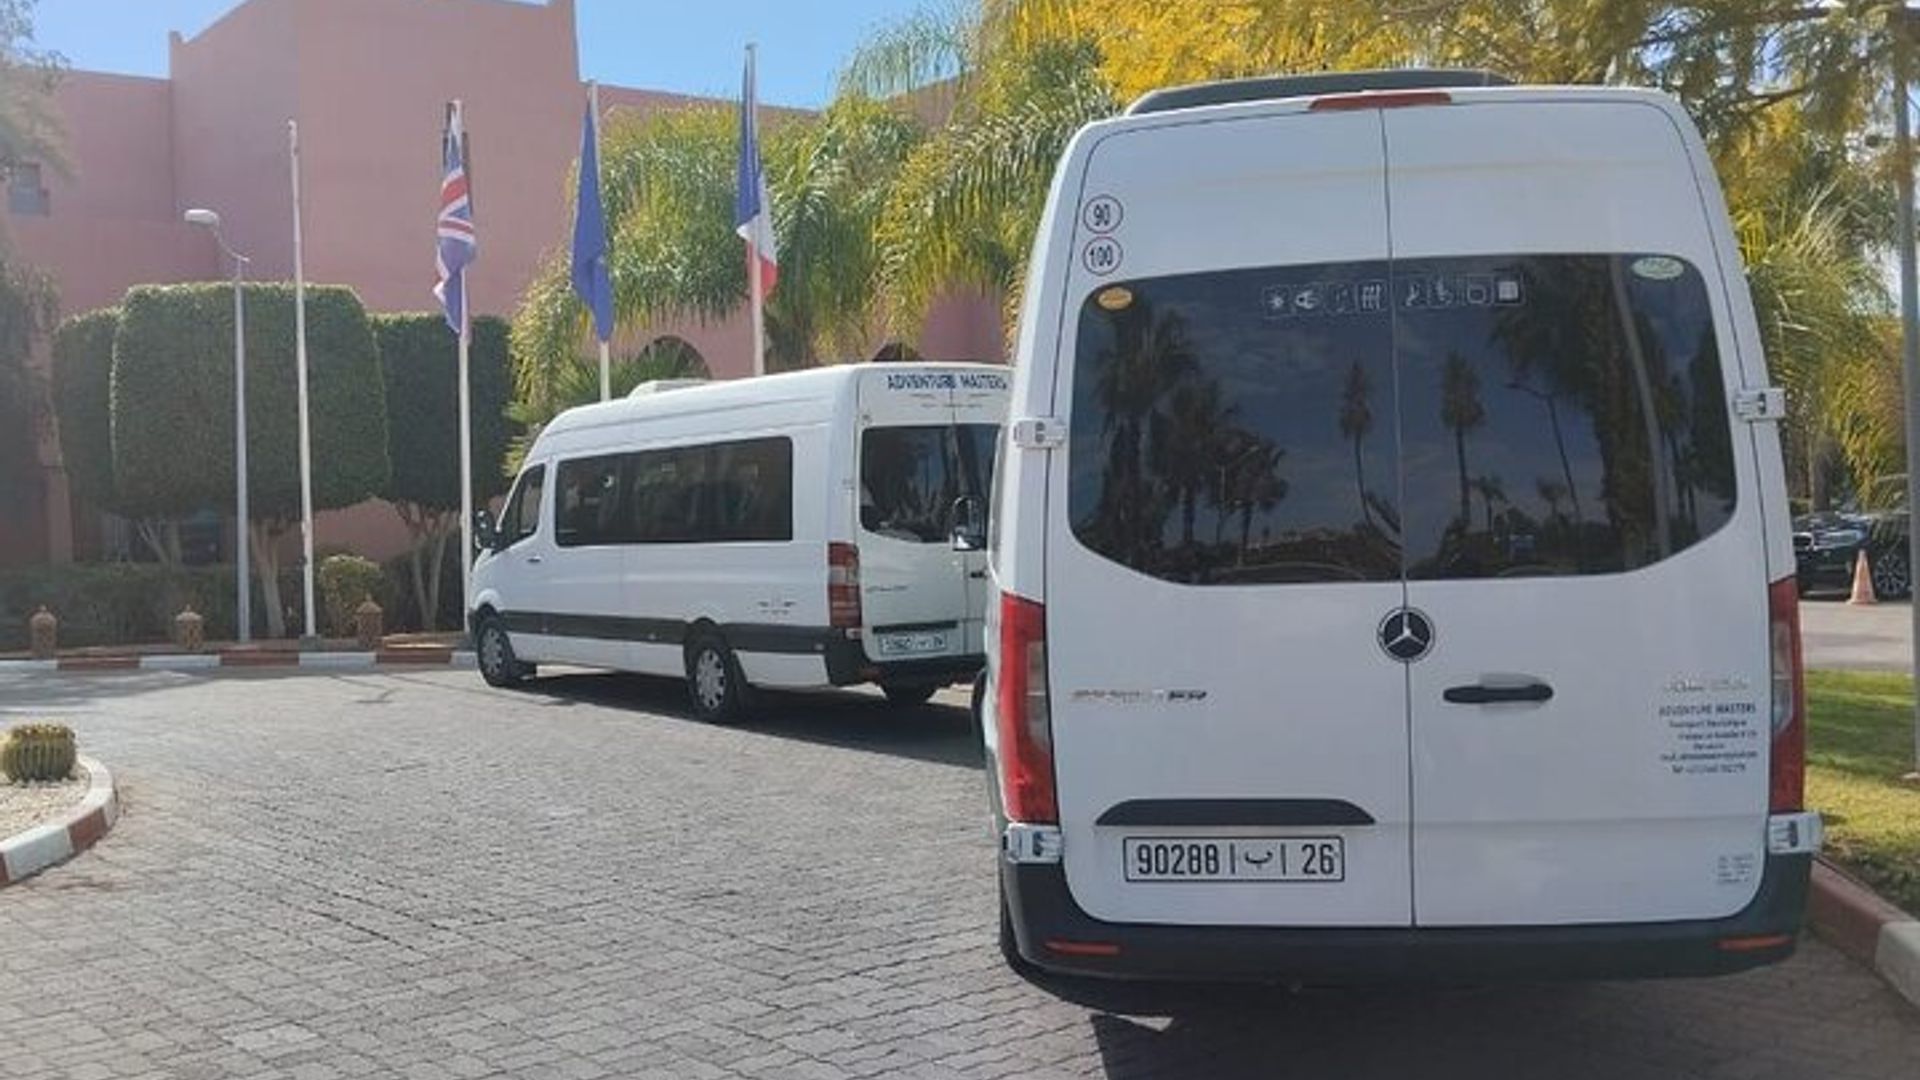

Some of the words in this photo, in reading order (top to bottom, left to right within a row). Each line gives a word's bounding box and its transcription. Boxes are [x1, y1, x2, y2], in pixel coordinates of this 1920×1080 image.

[1093, 203, 1111, 226] 90
[1089, 245, 1113, 267] 100
[887, 374, 956, 389] ADVENTURE
[1659, 704, 1712, 716] ADVENTURE
[1715, 702, 1756, 714] MASTERS
[1136, 843, 1220, 875] 90288
[1301, 843, 1335, 875] 26
